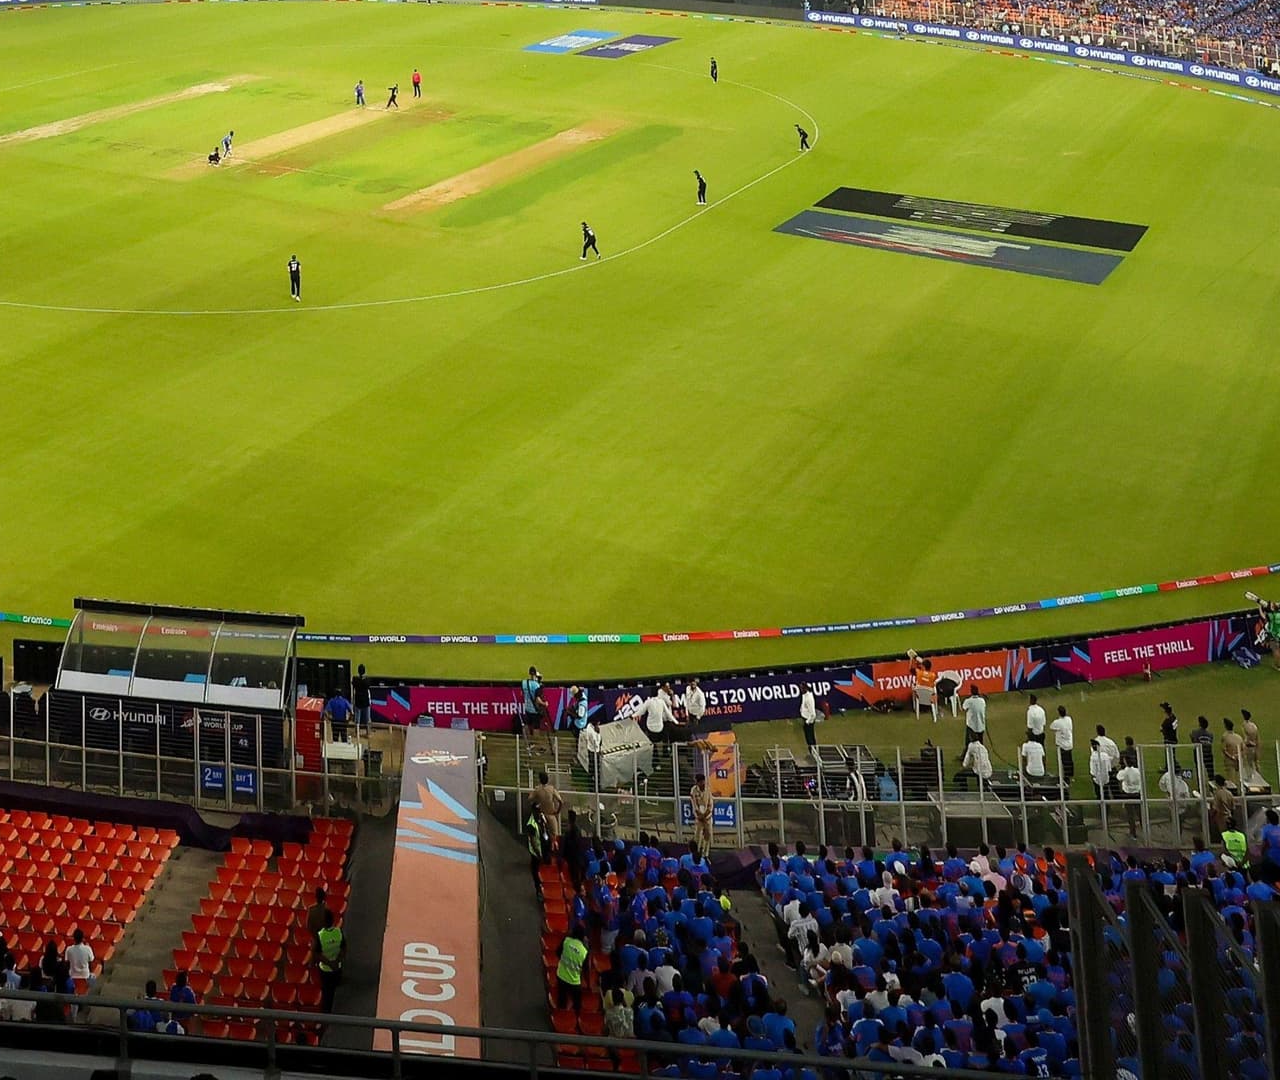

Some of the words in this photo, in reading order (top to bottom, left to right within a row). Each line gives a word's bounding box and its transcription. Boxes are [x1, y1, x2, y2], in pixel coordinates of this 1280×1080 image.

[927, 24, 961, 38] HYUNDAI
[980, 32, 1014, 46] HYUNDAI
[1034, 41, 1069, 54] HYUNDAI
[1089, 49, 1126, 62] HYUNDAI
[1146, 58, 1184, 72] HYUNDAI
[1204, 68, 1240, 83] HYUNDAI
[1004, 604, 1027, 613] WORLD
[22, 615, 53, 625] aramco
[941, 612, 965, 621] WORLD
[515, 635, 548, 643] aramco
[587, 635, 620, 643] aramco
[663, 633, 689, 641] Emirates
[733, 630, 759, 639] Emirates
[1104, 650, 1131, 664] FEEL
[1132, 645, 1155, 660] THE
[1155, 639, 1195, 655] THRILL
[674, 693, 719, 710] M'S
[720, 689, 753, 707] T20
[753, 683, 801, 703] WORLD
[427, 701, 460, 715] FEEL
[462, 702, 489, 715] THE
[113, 710, 166, 725] HYUNDAI
[205, 767, 212, 781] 2
[247, 772, 253, 787] 1
[683, 804, 691, 818] 5
[726, 804, 734, 819] 4
[400, 942, 456, 1002] CUP
